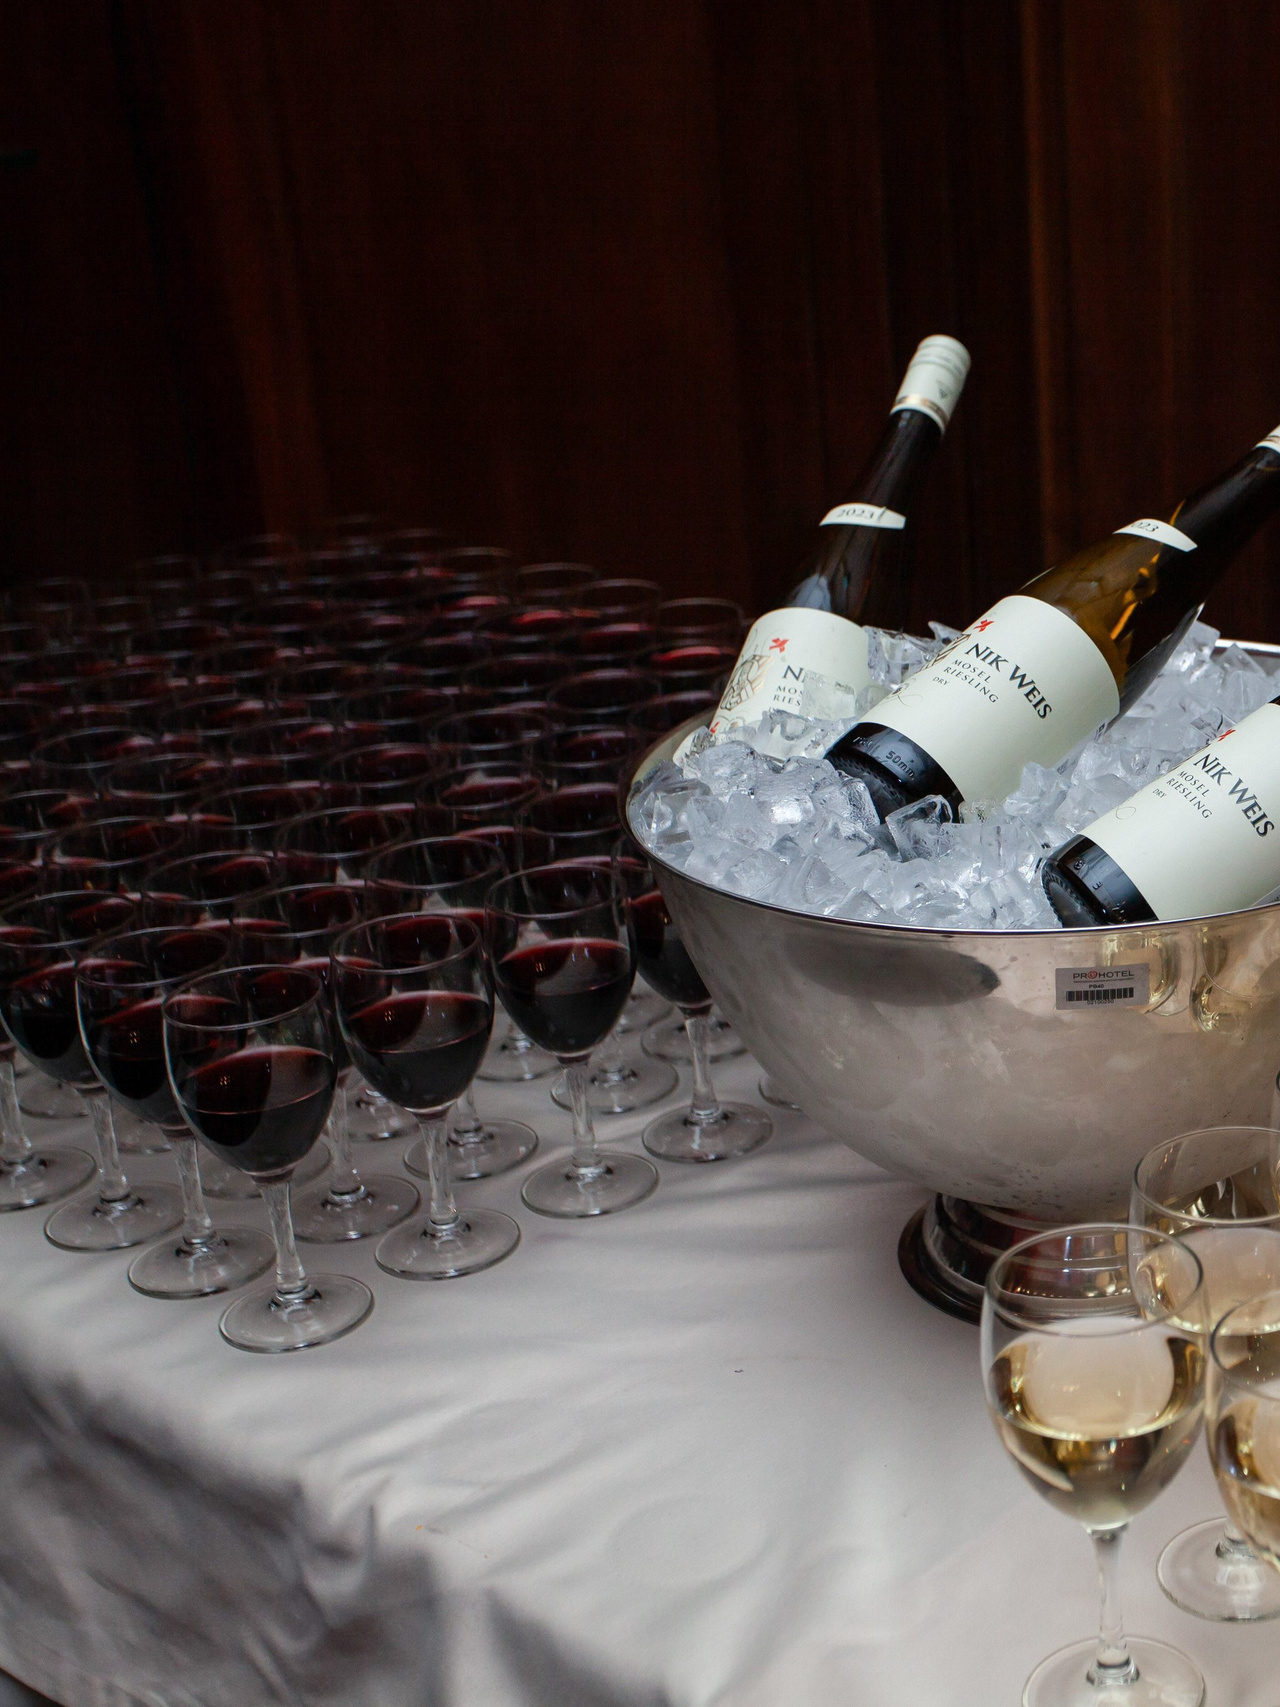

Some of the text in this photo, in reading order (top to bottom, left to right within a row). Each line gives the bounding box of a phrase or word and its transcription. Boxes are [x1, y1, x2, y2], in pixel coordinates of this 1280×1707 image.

[836, 507, 875, 520] 2023
[932, 676, 950, 686] DRY
[943, 666, 999, 703] RIESLING
[951, 659, 993, 684] MOSEL
[964, 642, 1053, 719] NIK WEIS
[773, 695, 801, 706] RIES
[1152, 788, 1167, 799] DRY
[1177, 770, 1210, 797] MOSEL
[1193, 753, 1275, 837] NIK WEIS
[1166, 777, 1213, 819] RIESLING
